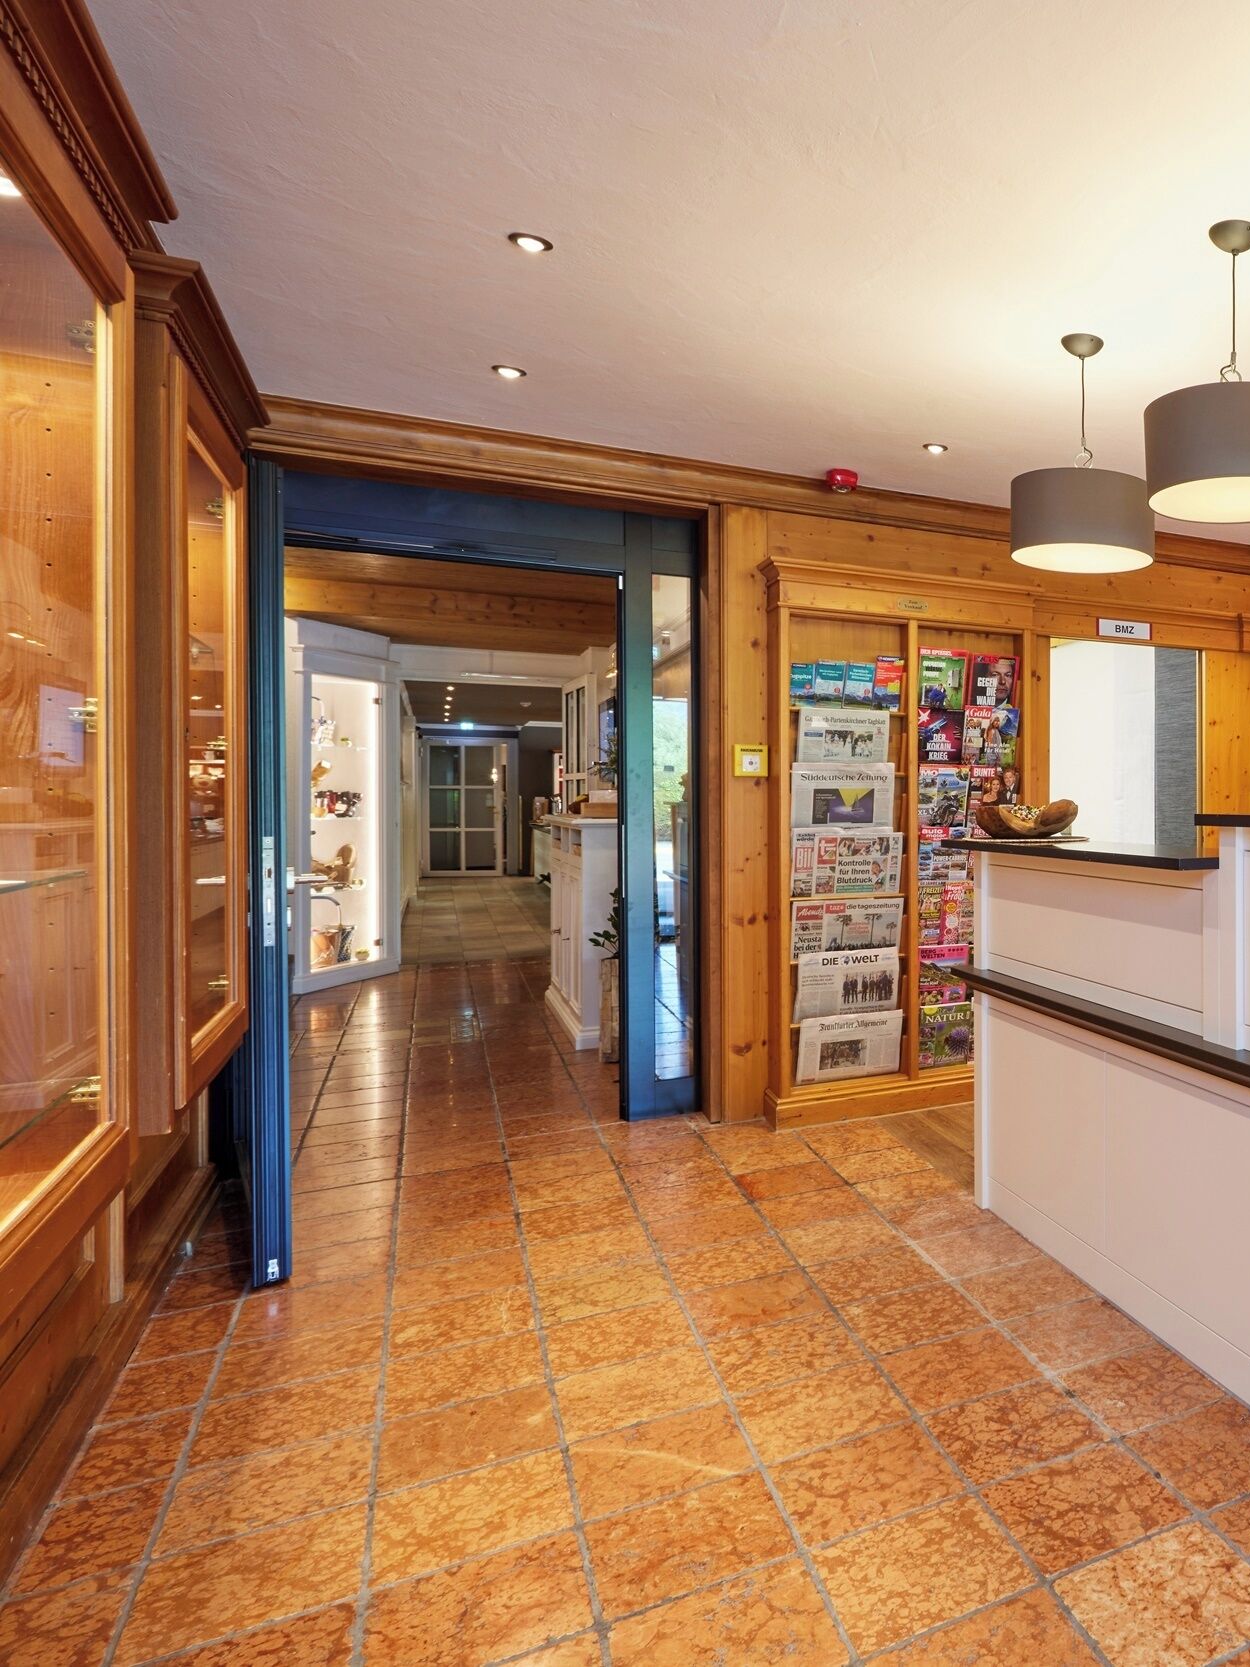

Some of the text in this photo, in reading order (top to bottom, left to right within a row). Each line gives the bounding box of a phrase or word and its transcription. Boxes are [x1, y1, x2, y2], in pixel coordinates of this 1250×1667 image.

[1115, 624, 1135, 635] BMZ
[977, 677, 998, 687] GEGEN
[986, 687, 997, 697] DIE
[976, 696, 996, 705] WAND
[969, 708, 992, 718] Gala
[933, 733, 946, 741] DER
[926, 742, 952, 750] KOKAIN
[800, 771, 888, 782] Süddeutsche Zeitung
[973, 768, 996, 776] BUNTE
[836, 876, 873, 884] Blutdruck
[857, 903, 900, 911] tageszeitung
[822, 957, 839, 966] DIE
[925, 1012, 965, 1023] NATUR
[818, 1019, 888, 1032] Frankfurter Allgemeine
